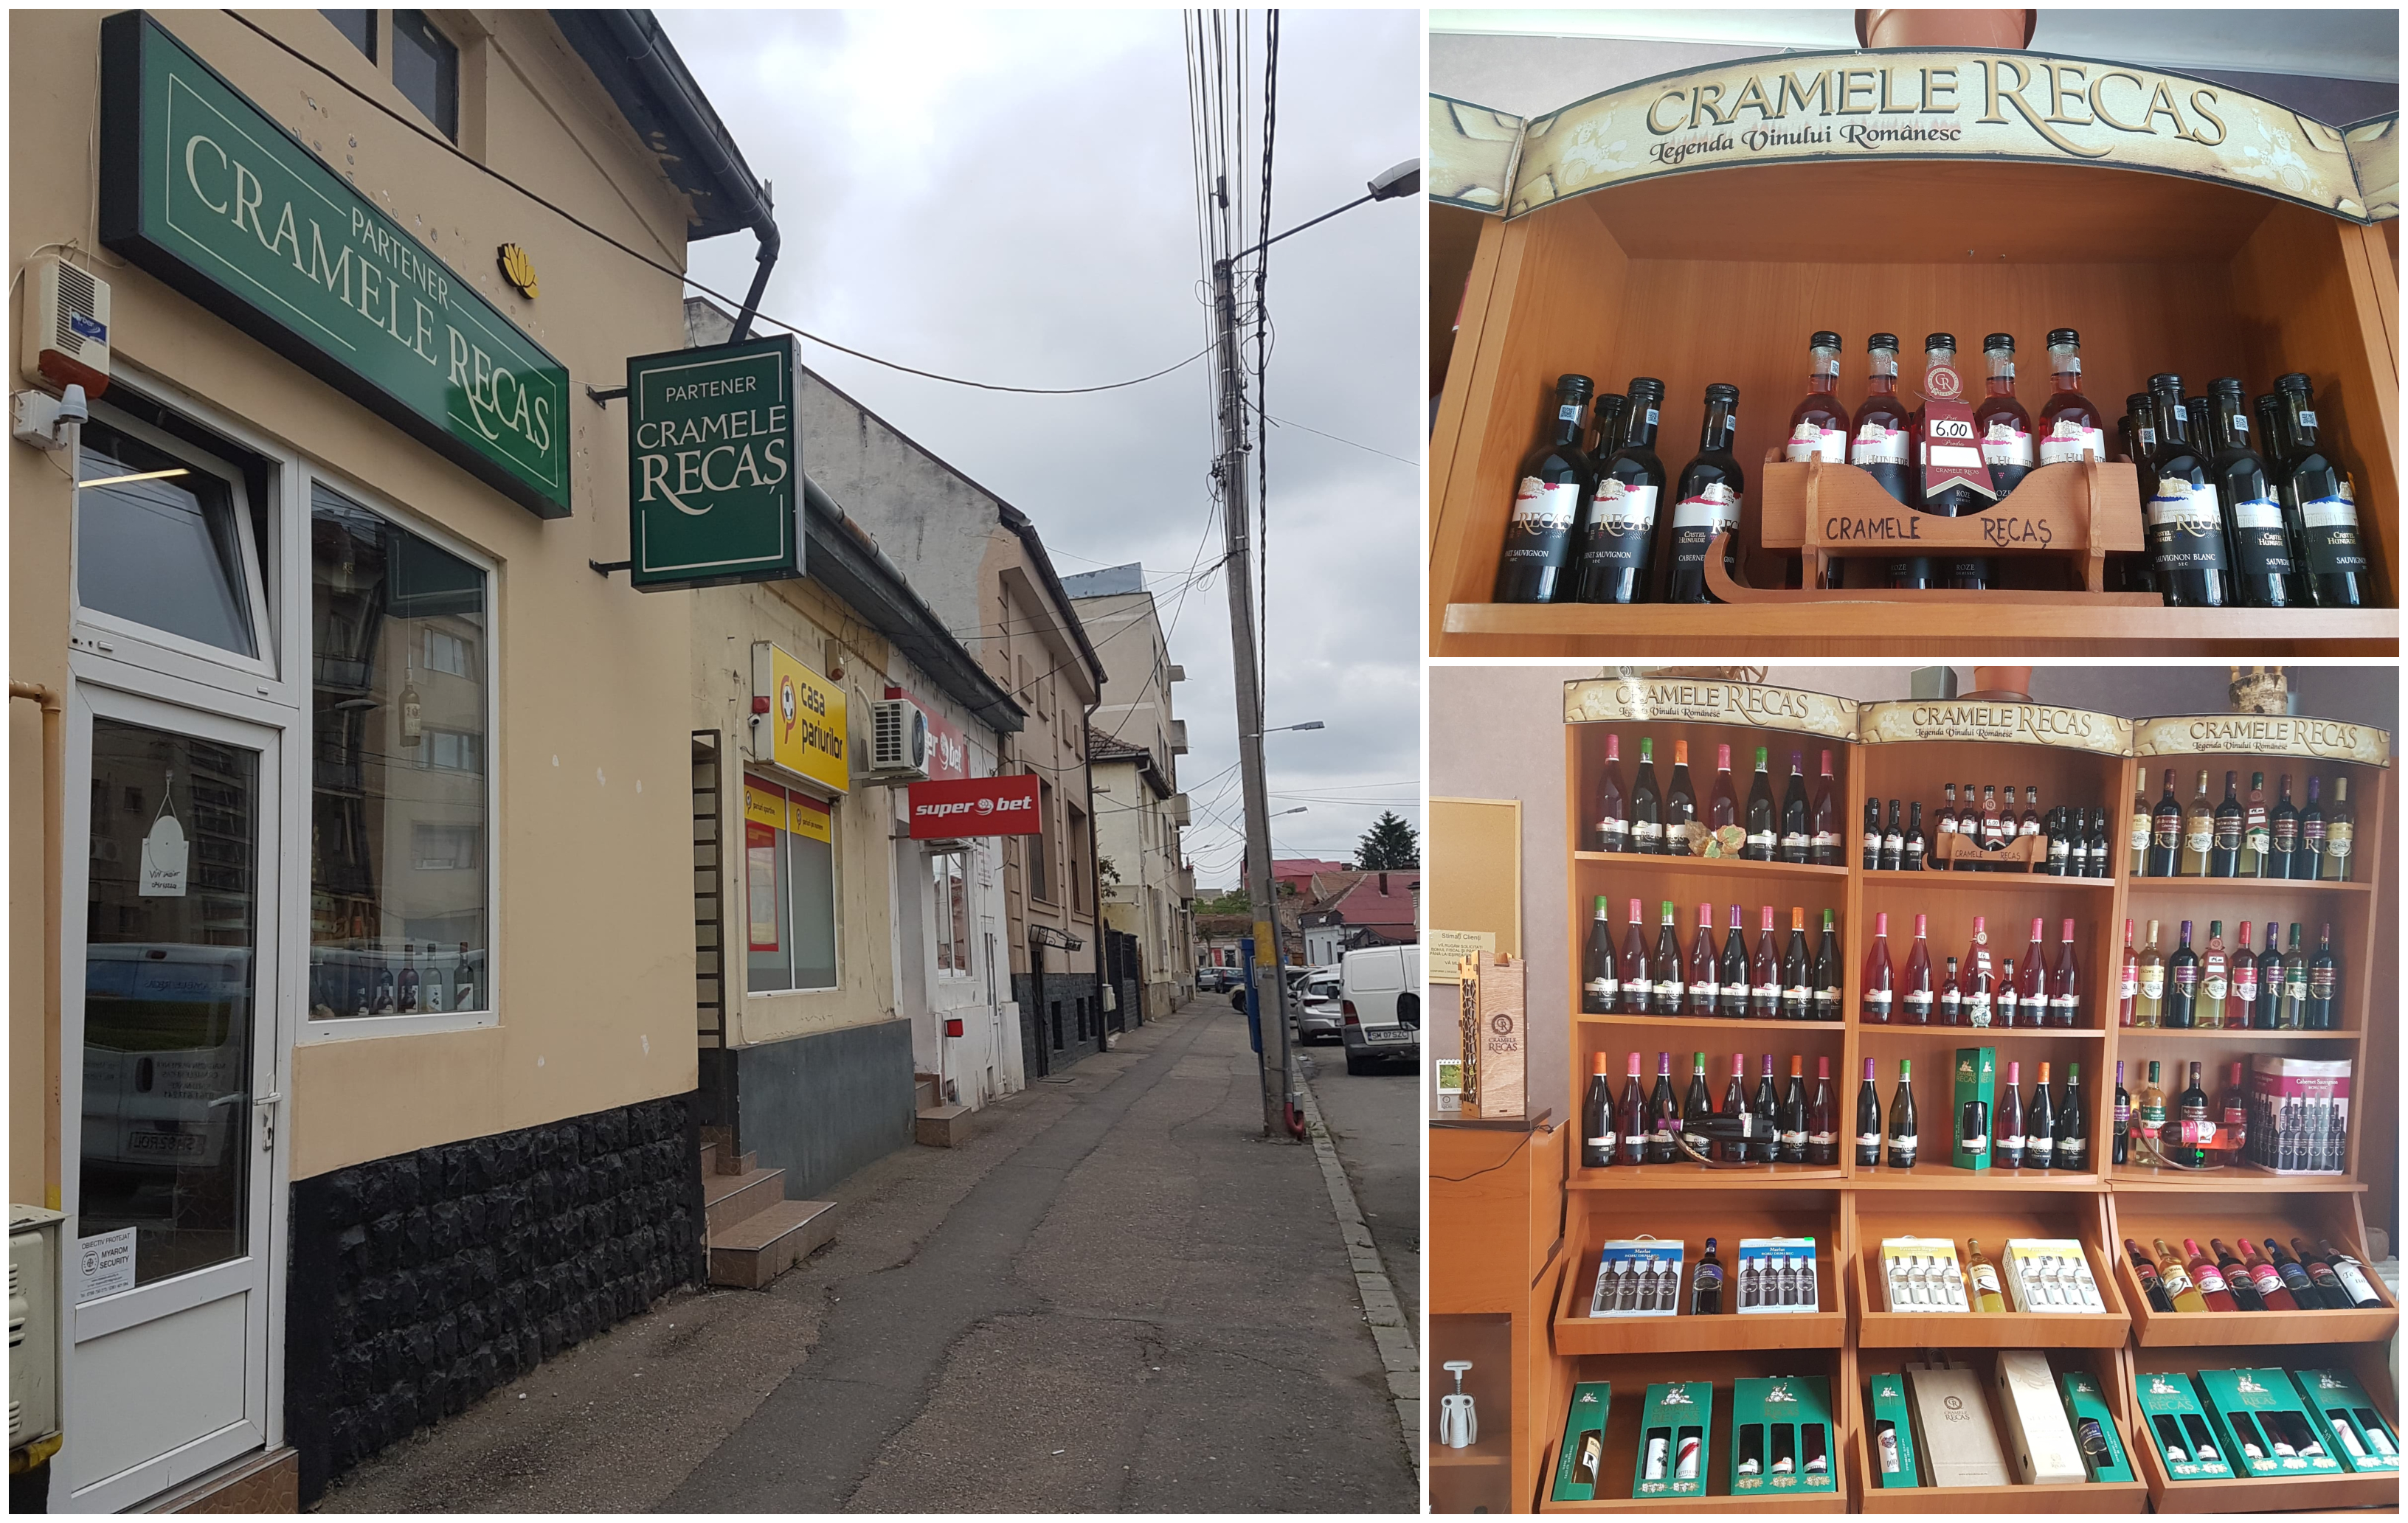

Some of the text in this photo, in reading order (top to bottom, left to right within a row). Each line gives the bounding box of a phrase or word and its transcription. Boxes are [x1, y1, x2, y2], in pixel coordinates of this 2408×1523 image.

[1646, 59, 2227, 157] CRAMELE RECAS
[1650, 123, 1961, 164] Legenda Vinului Românesc
[352, 206, 449, 310] PARTENER
[185, 134, 550, 459] CRAMELE RECAȘ
[666, 376, 756, 402] PARTENER
[637, 405, 786, 449] CRAMELE
[637, 438, 786, 516] RECAȘ
[1956, 490, 1970, 498] ROZE
[1711, 518, 1740, 534] REC
[1826, 516, 1920, 541] CRAMELE
[2156, 553, 2190, 562] SAUVIGNON
[801, 681, 825, 713] casa
[1616, 684, 1809, 726] CAMELE RECAS
[1650, 707, 1721, 719] Vinului Românesc
[1913, 706, 2092, 744] CRAMELE RECAS
[802, 718, 843, 761] pariurilor
[1915, 727, 2013, 740] Legenda Vinului Românesc
[2190, 720, 2358, 755] CRAMELE RECAS
[2193, 742, 2288, 751] Legenda Vinului Românesc
[916, 796, 1032, 817] super bet
[1955, 850, 1983, 858] CRAMELE
[105, 1232, 130, 1244] PROTEJAT
[100, 1255, 129, 1269] SECURITY
[101, 1246, 128, 1258] MYAROM
